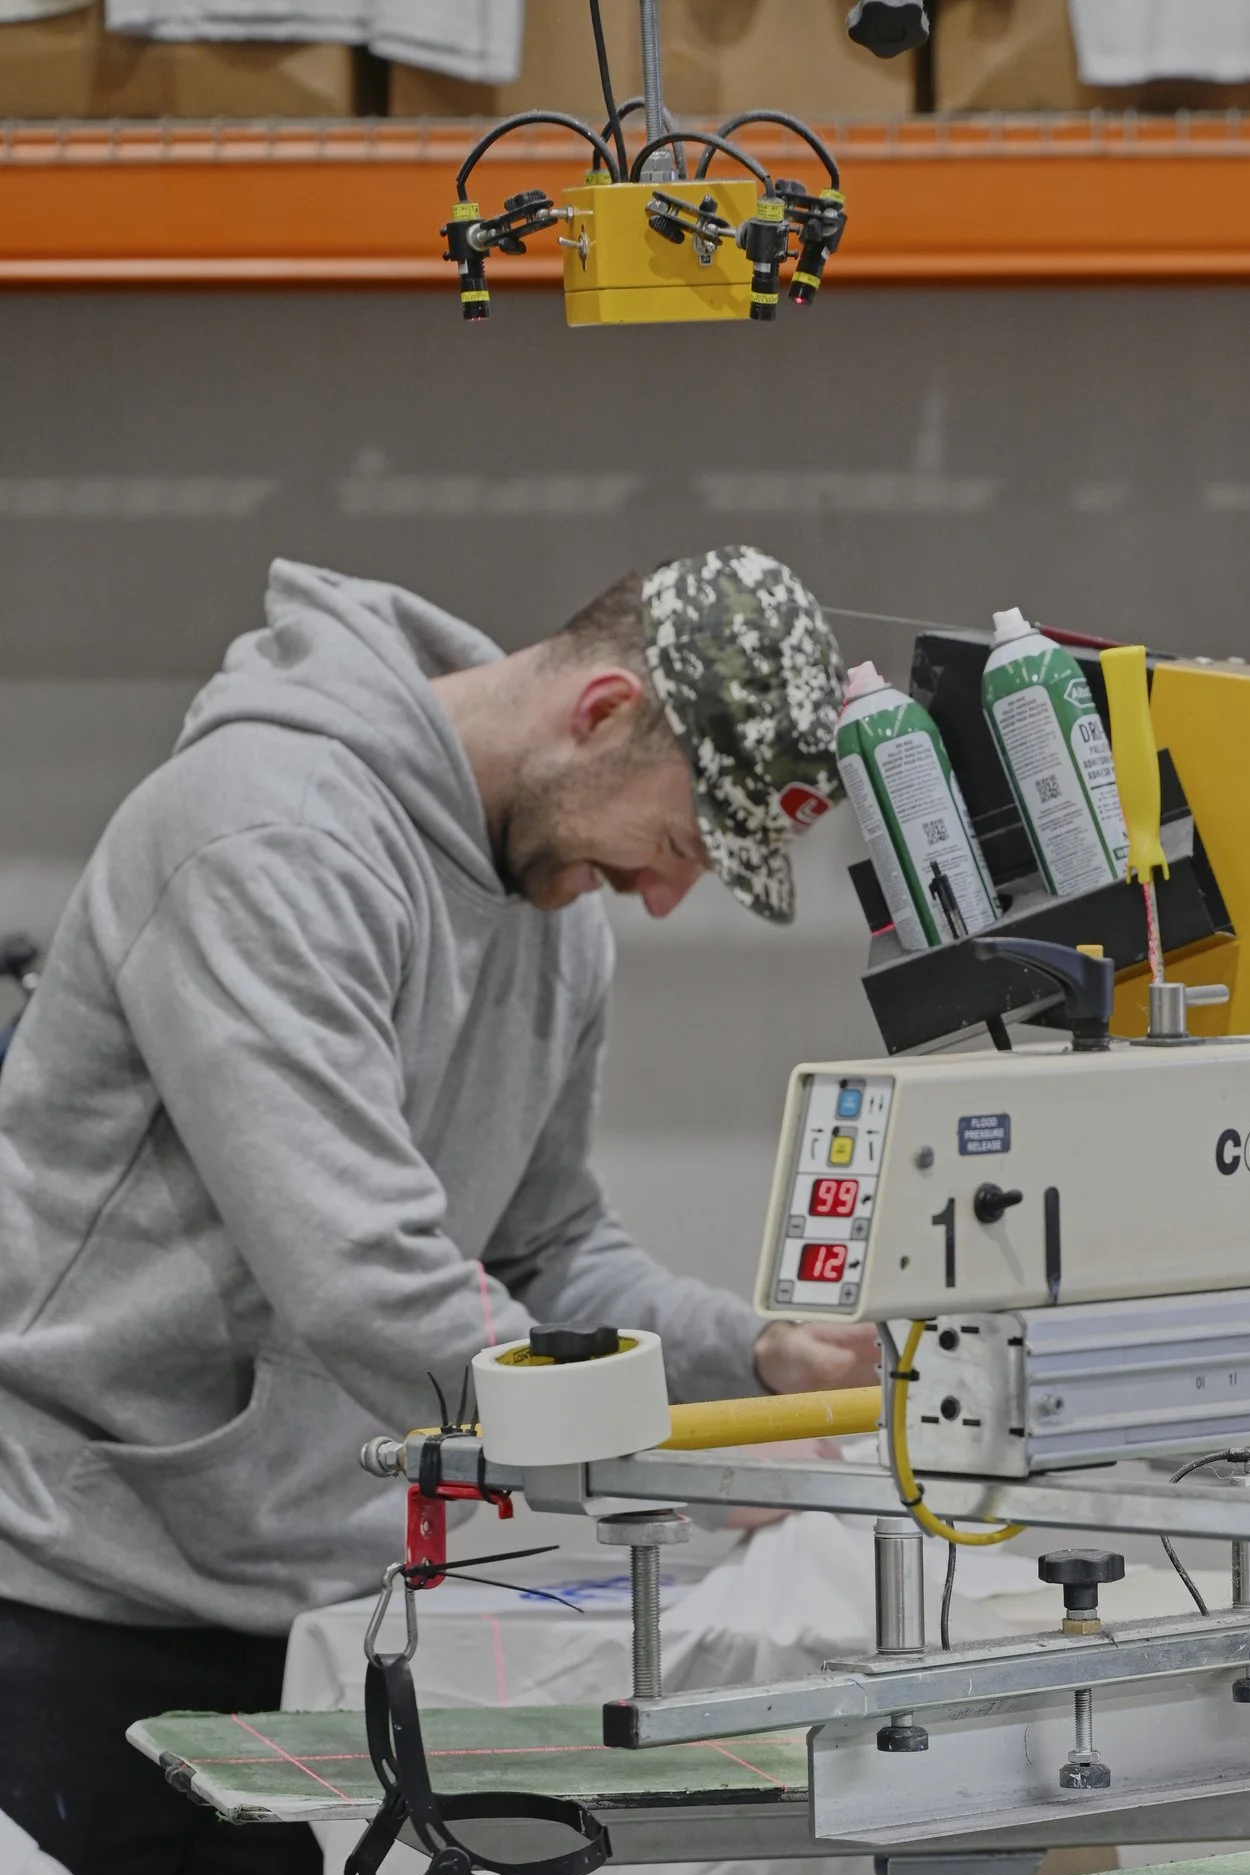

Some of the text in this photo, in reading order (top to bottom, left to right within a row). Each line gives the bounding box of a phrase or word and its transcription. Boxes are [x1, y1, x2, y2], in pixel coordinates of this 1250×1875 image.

[963, 1127, 1005, 1141] PRESSURE
[970, 1116, 999, 1129] FLOOD
[966, 1139, 1002, 1153] RELEASE
[816, 1179, 858, 1214] 99
[932, 1198, 956, 1288] 1
[813, 1245, 847, 1279] 12
